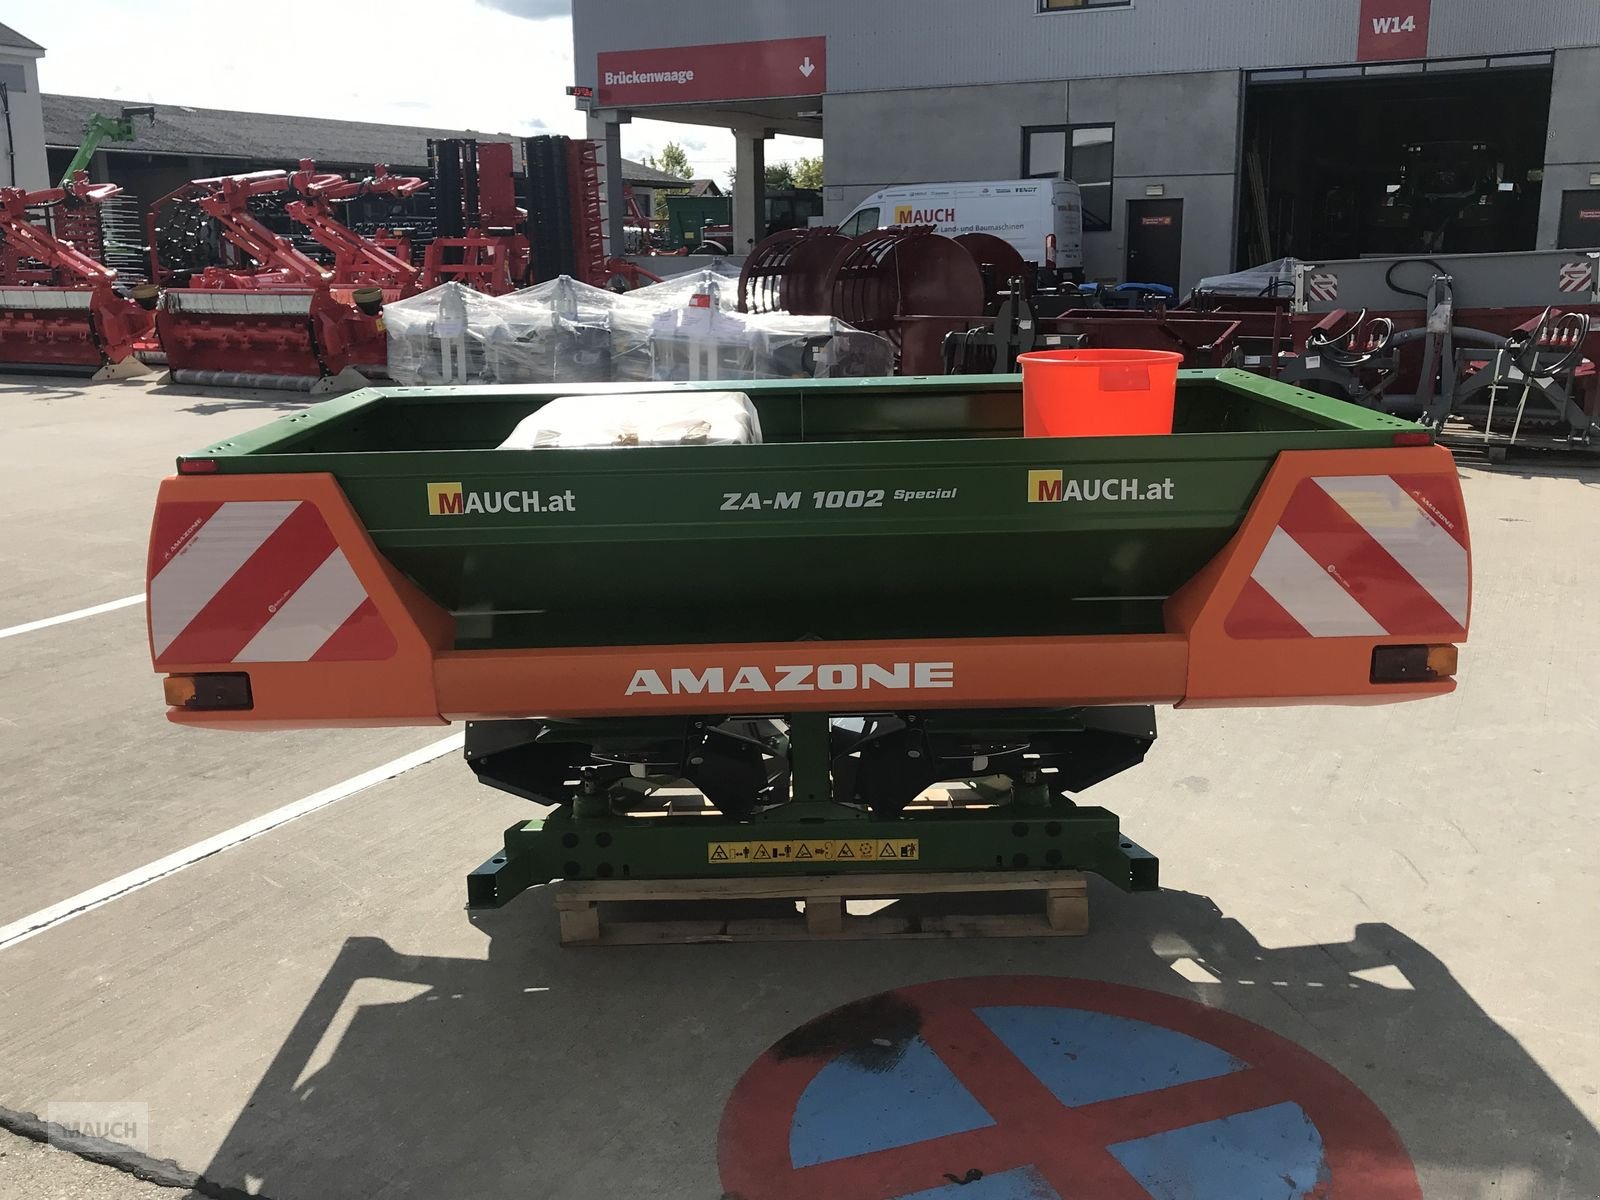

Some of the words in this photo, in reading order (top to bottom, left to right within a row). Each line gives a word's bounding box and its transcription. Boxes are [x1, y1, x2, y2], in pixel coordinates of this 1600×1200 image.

[1372, 15, 1416, 35] W14
[604, 70, 694, 86] Brückenwaage
[899, 208, 955, 224] MAUCH
[960, 224, 973, 232] und
[975, 223, 1025, 232] Baumaschinen
[720, 491, 802, 511] ZA-M
[812, 489, 885, 509] 1002
[893, 487, 957, 502] Special
[1038, 477, 1175, 502] MAUCH.at
[438, 489, 576, 515] MAUCH.at
[1421, 497, 1454, 529] AMAZONE
[624, 661, 954, 696] AMAZONE
